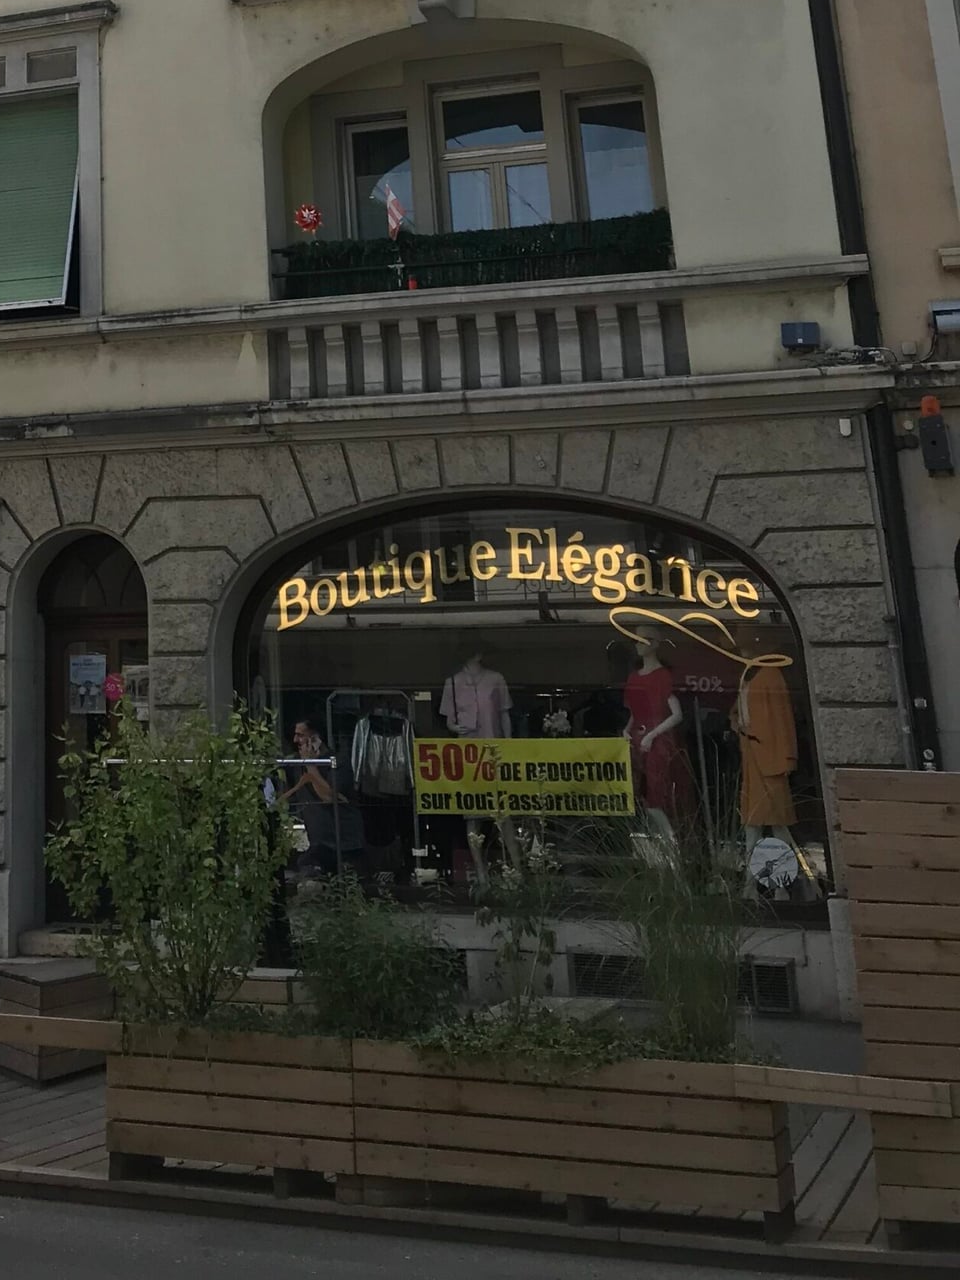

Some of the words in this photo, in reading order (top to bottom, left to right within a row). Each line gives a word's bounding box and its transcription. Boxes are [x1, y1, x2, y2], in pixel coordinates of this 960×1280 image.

[277, 540, 498, 631] Boutique
[505, 527, 761, 617] Elégance
[419, 743, 496, 782] 50%
[500, 763, 522, 781] DE
[421, 792, 452, 810] sur
[456, 791, 494, 810] tout
